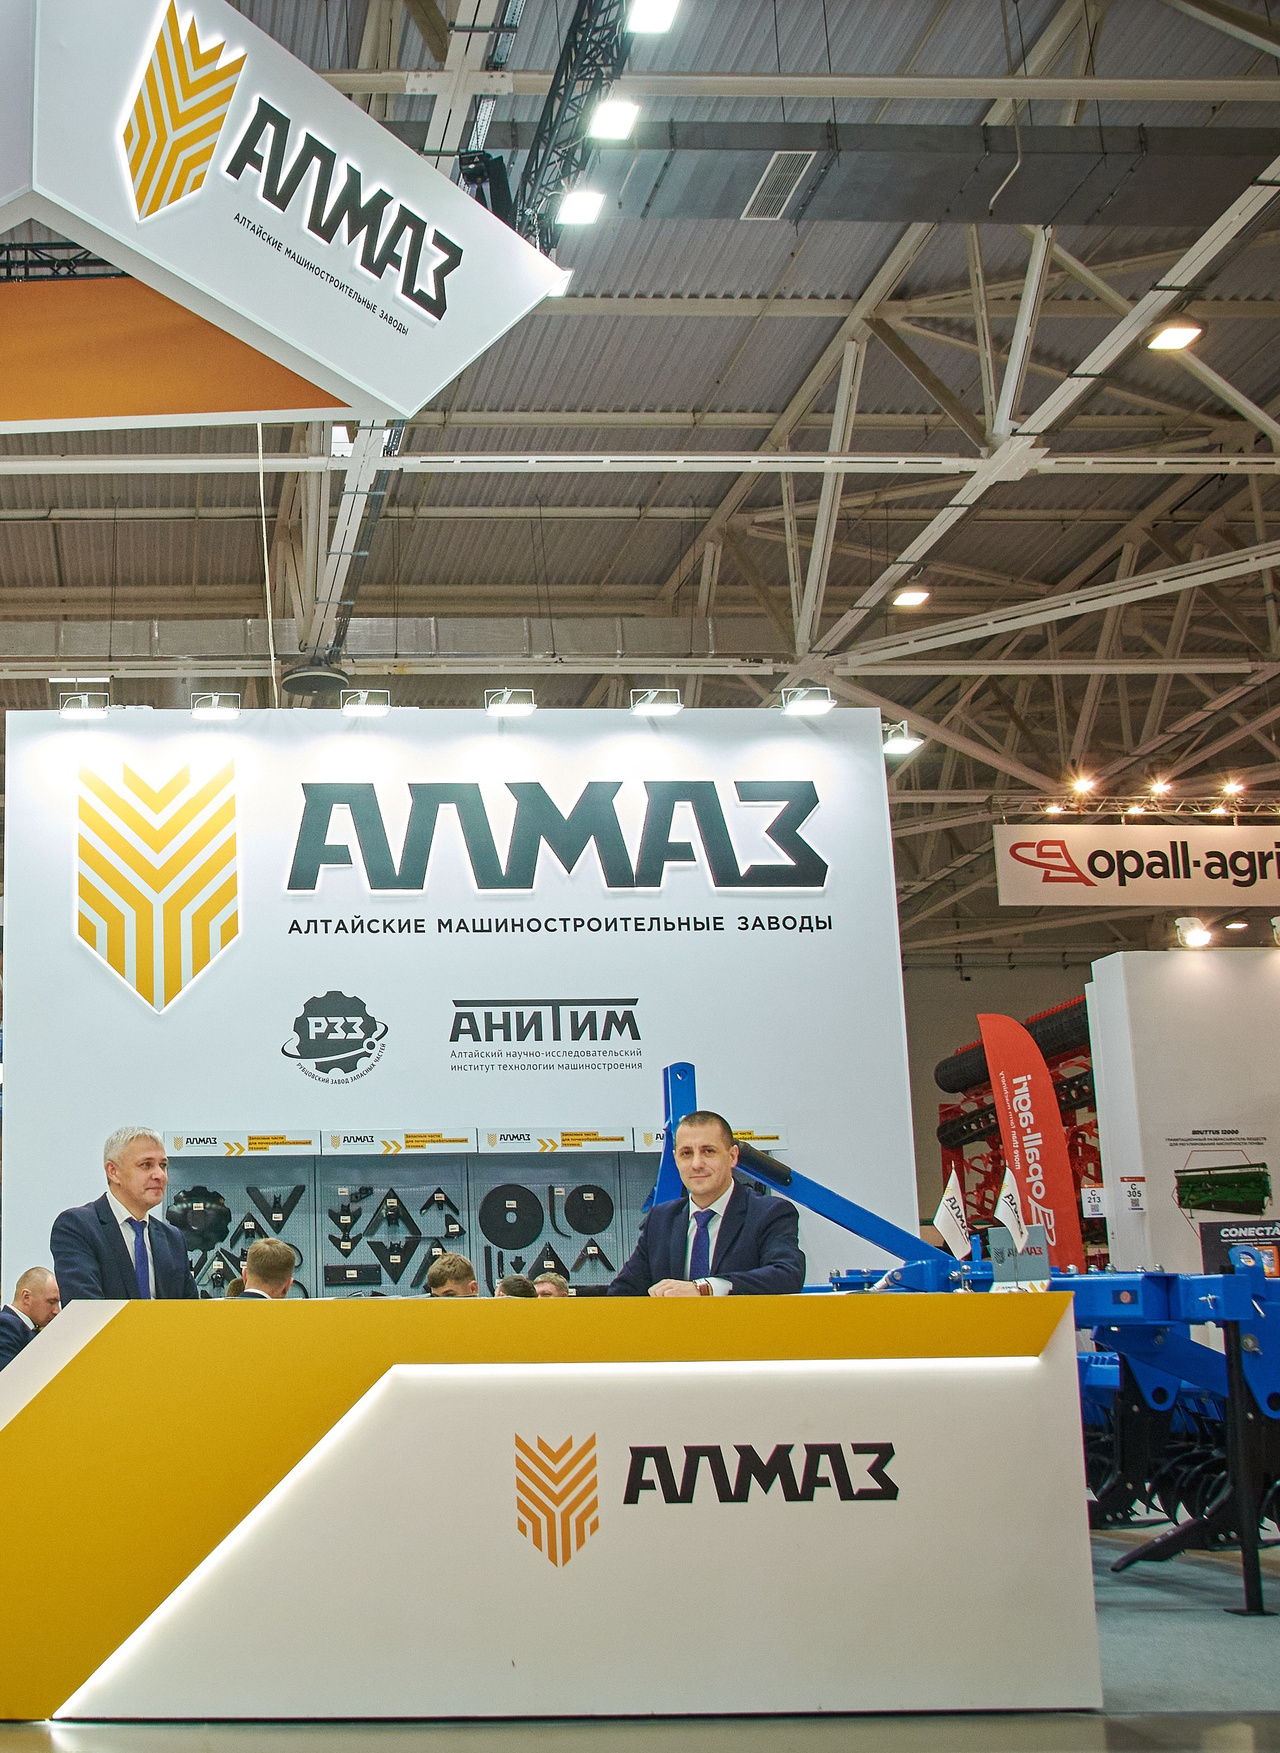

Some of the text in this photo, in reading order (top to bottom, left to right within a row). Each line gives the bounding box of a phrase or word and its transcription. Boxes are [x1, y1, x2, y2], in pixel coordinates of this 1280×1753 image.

[225, 97, 464, 320] АЛМАЗ
[234, 212, 409, 335] АЛТАЙСКИЕ МАШИНОСТРОИТЕЛЬНЫЕ ЗАВОДЫ
[287, 780, 829, 891] АЛМАЗ
[288, 914, 833, 935] АЛТАЙСКИЕ МАШИНОСТРОИТЕЛЬНЫЕ ЗАВОДЫ
[450, 1048, 642, 1060] Алтайский научно-исследовательский
[296, 1062, 330, 1085] РУБЦОВСКИЙ
[350, 1064, 375, 1082] ЗАПАСНЫХ
[374, 1043, 386, 1063] ЧАСТЕЙ
[450, 1061, 643, 1074] институт технологии машиностроения
[186, 1137, 217, 1145] АЛМАЗ
[342, 1135, 375, 1143] АЛМАЗ
[500, 1133, 531, 1141] АЛМАЗ
[1127, 1190, 1142, 1198] 305
[623, 1442, 900, 1505] АЛМАЗ
